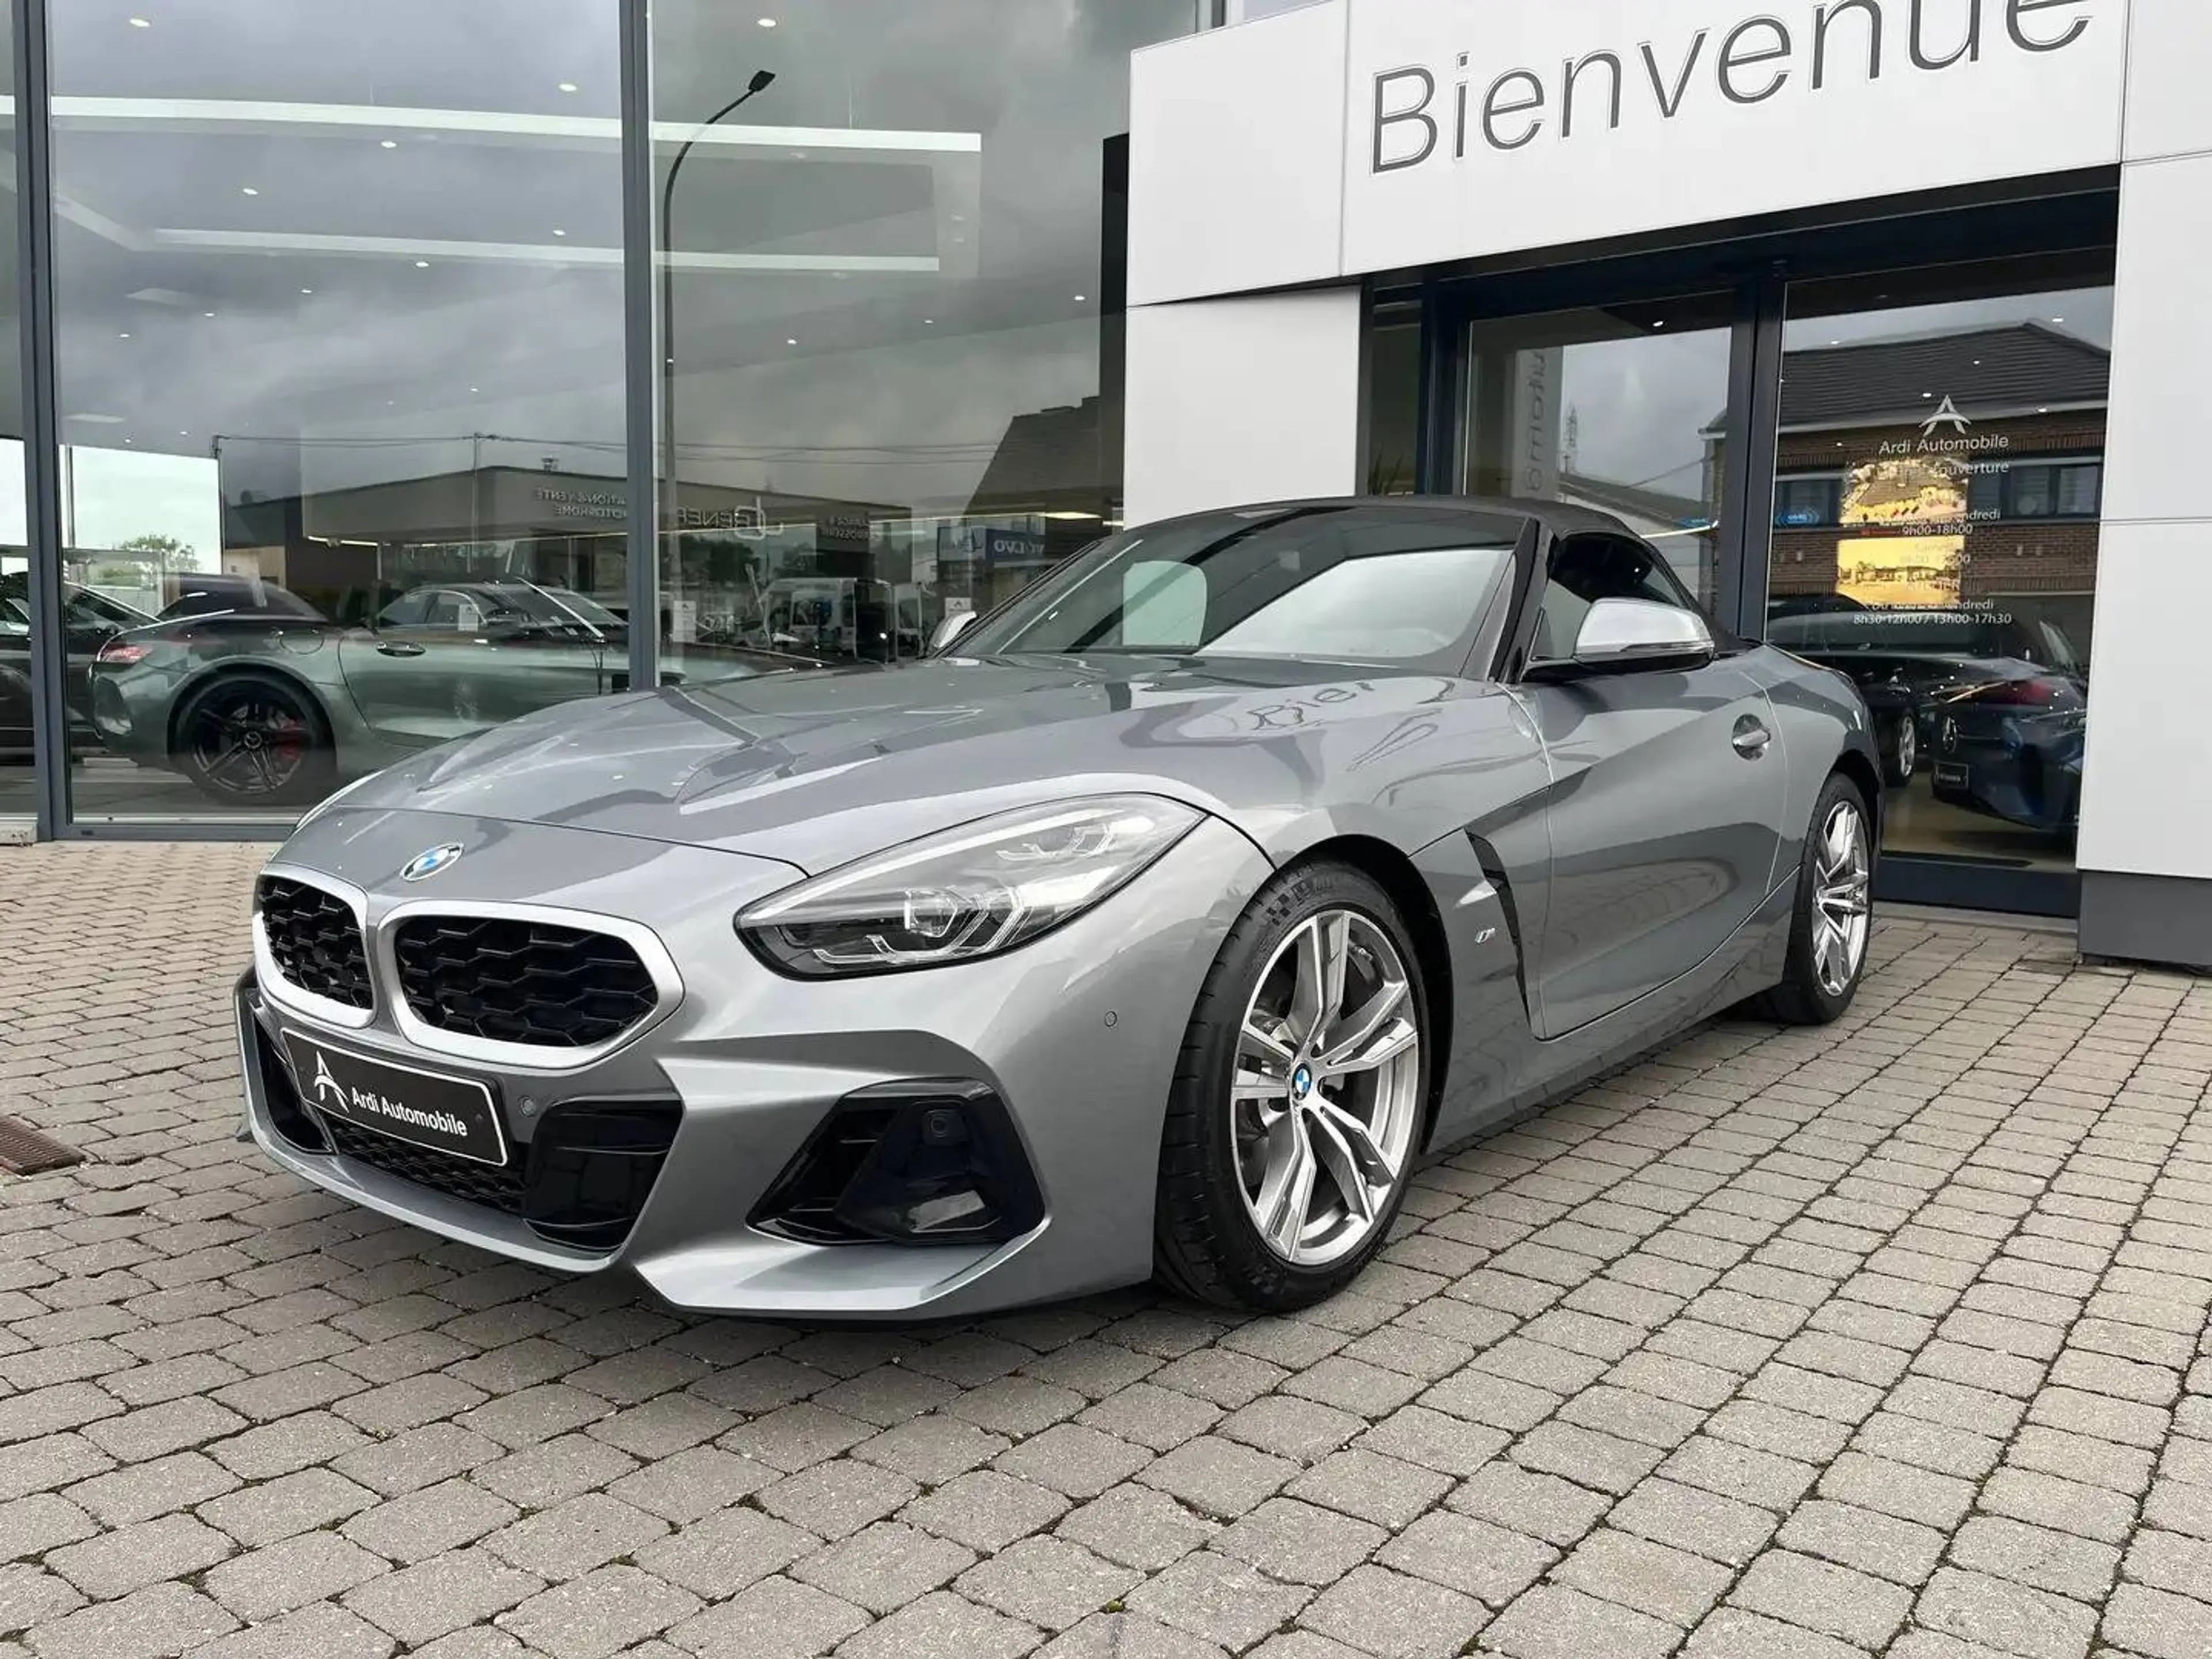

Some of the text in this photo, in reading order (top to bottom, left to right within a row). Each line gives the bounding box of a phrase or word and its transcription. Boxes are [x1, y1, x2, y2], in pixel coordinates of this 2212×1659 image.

[1371, 0, 2092, 174] Bienvenue
[1878, 434, 2009, 454] Ardi Automobile
[1902, 524, 1973, 535] 9h00-18h00
[353, 1087, 468, 1136] Ardi Automobile
